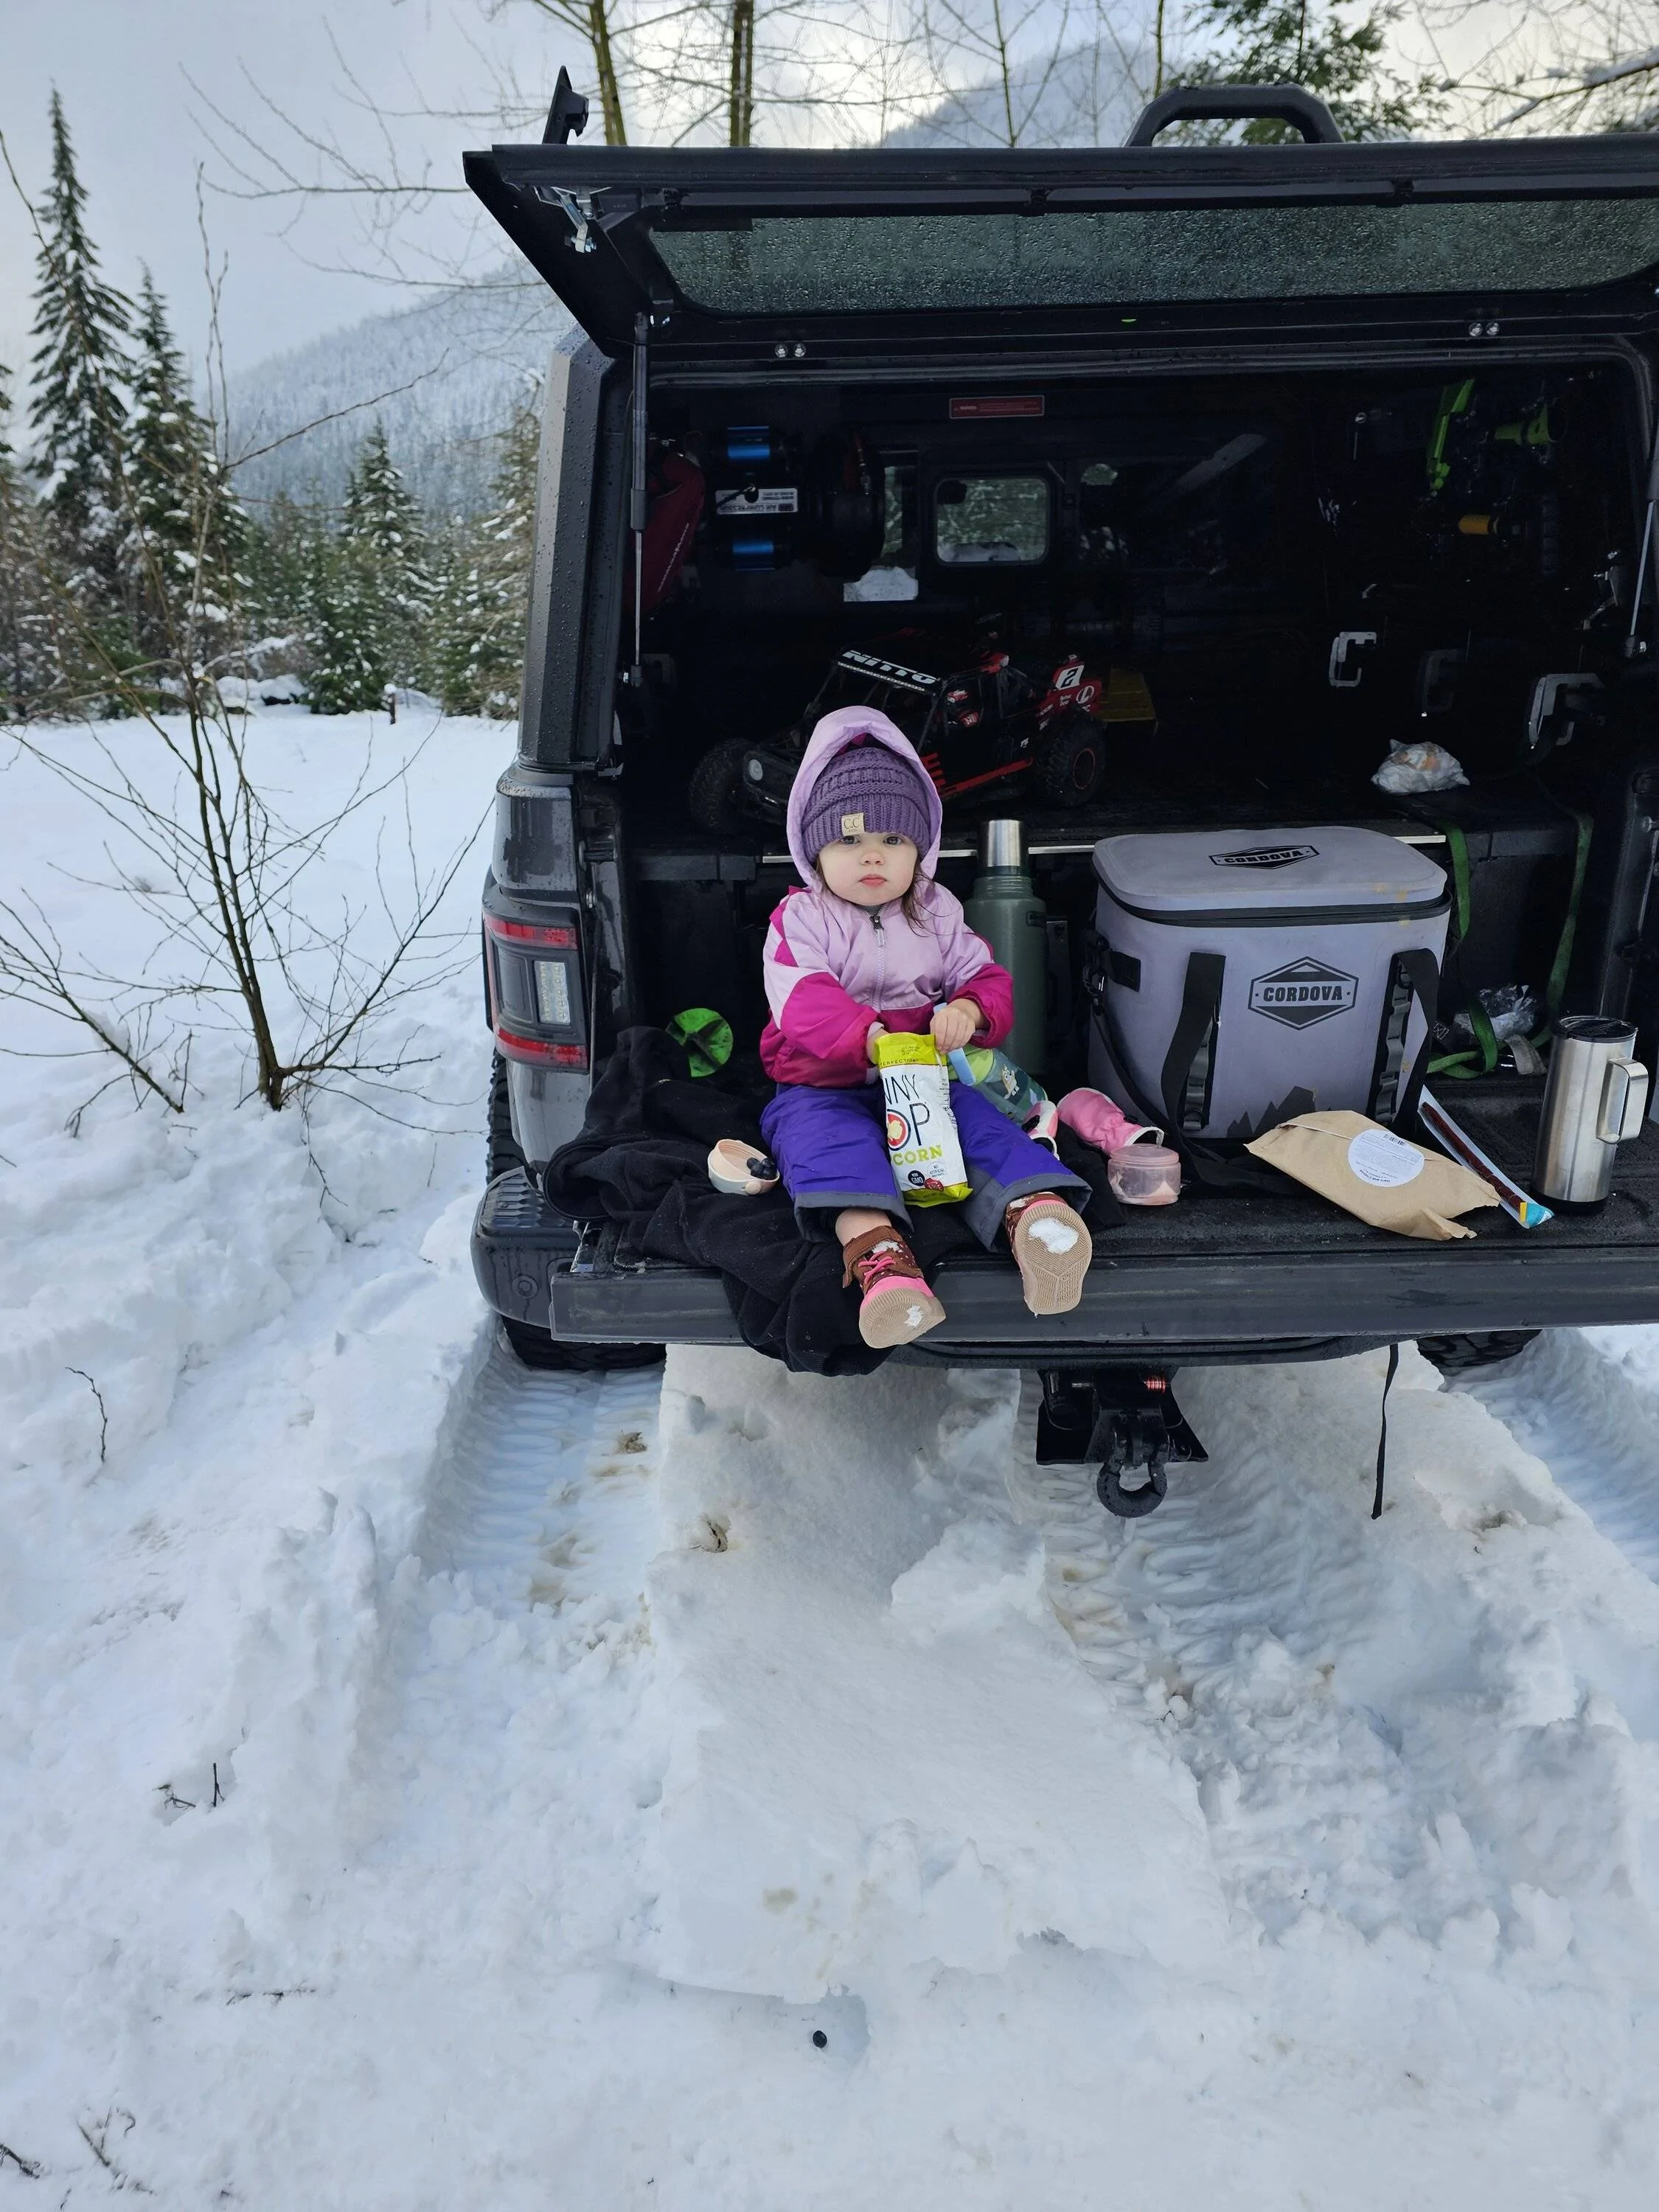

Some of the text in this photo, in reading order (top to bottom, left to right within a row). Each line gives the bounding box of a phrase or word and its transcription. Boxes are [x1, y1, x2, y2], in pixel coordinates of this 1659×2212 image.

[842, 650, 936, 684] NITTO
[1060, 667, 1079, 688] 2
[1223, 850, 1304, 863] CORDOVA
[1263, 985, 1343, 1002] CORDOVA
[885, 1074, 919, 1105] NNY
[887, 1102, 931, 1151] OP
[891, 1144, 943, 1166] CORN
